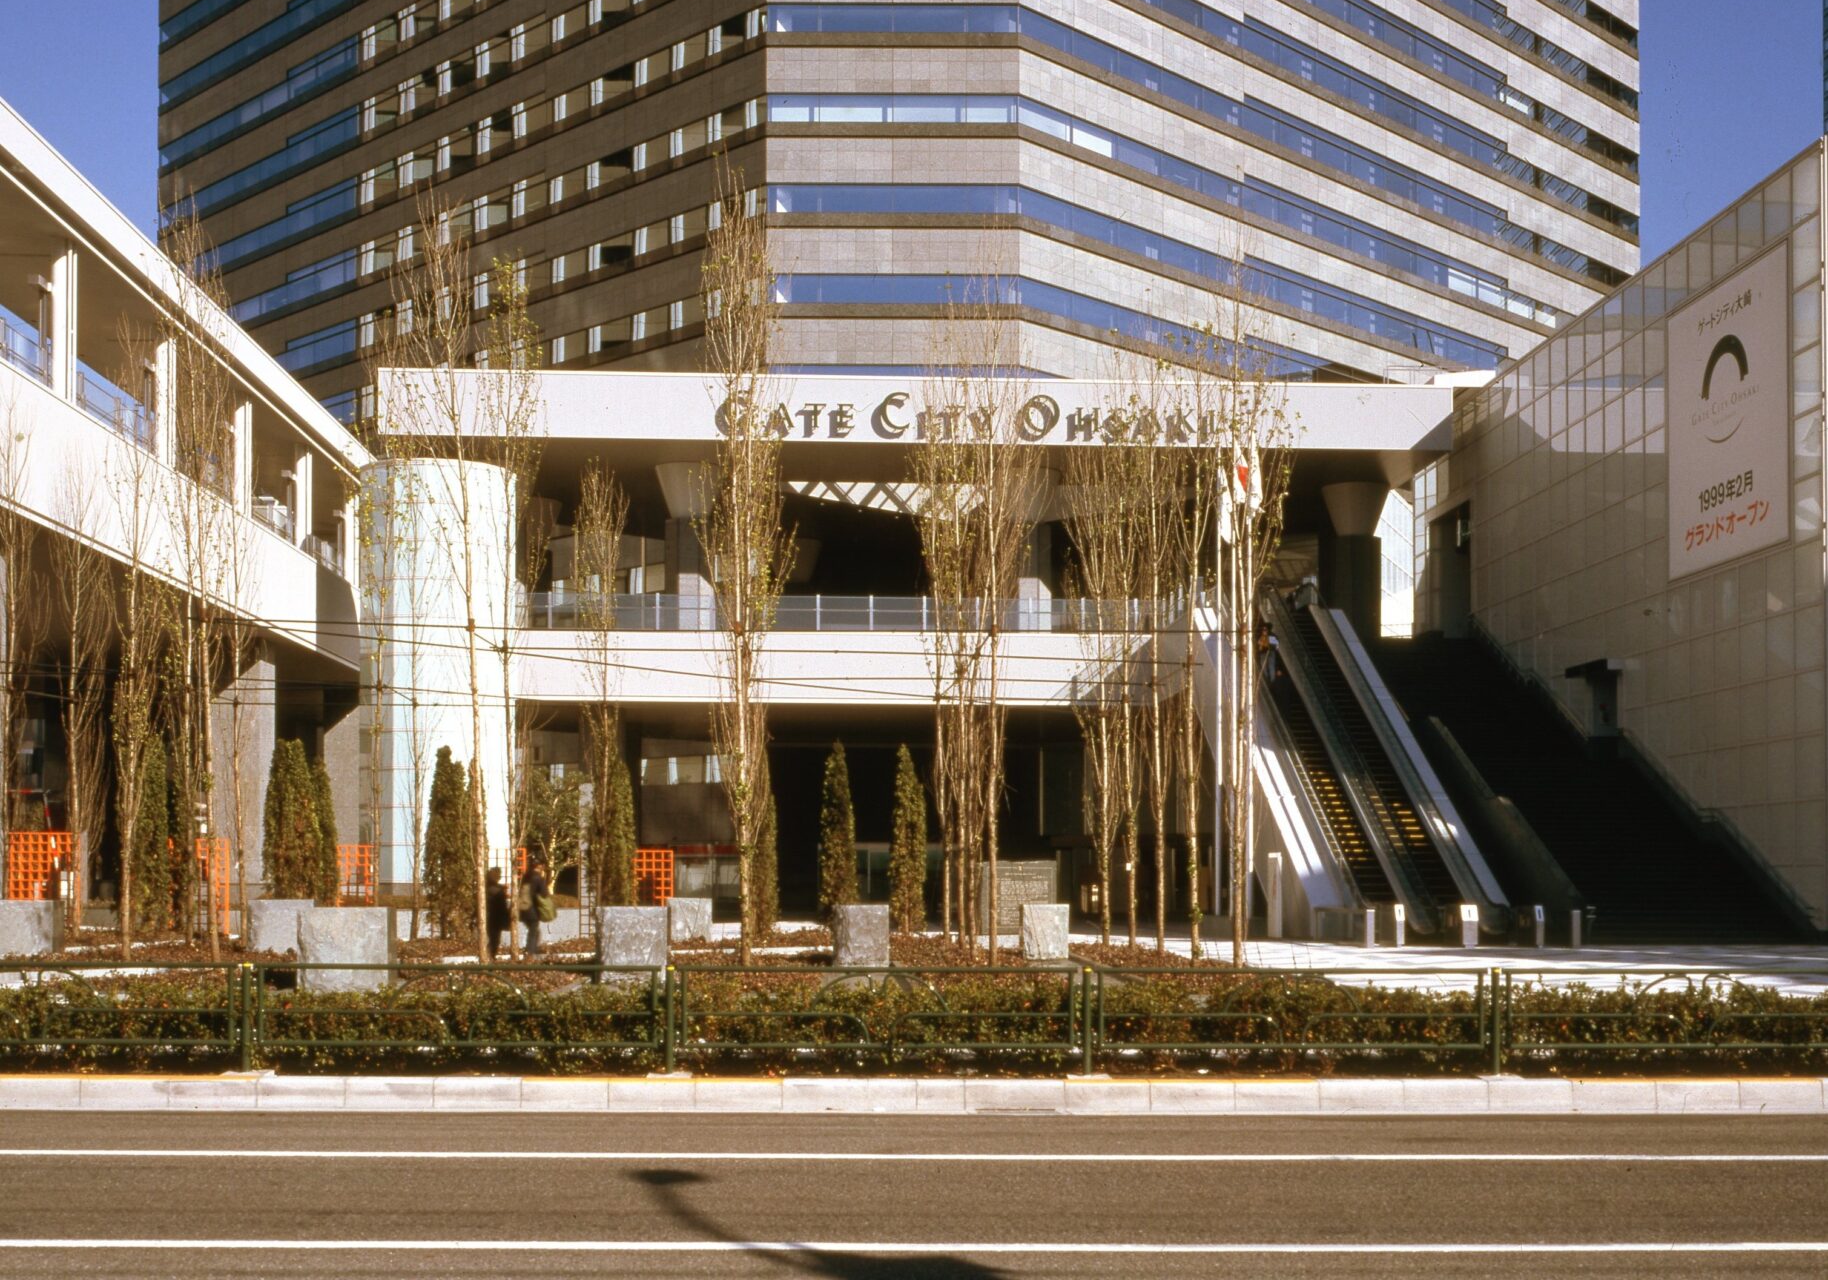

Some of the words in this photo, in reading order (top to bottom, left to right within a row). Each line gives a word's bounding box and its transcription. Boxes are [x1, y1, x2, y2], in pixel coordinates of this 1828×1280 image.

[1698, 469, 1753, 513] 1999年2月
[1685, 500, 1770, 551] グランドオープン
